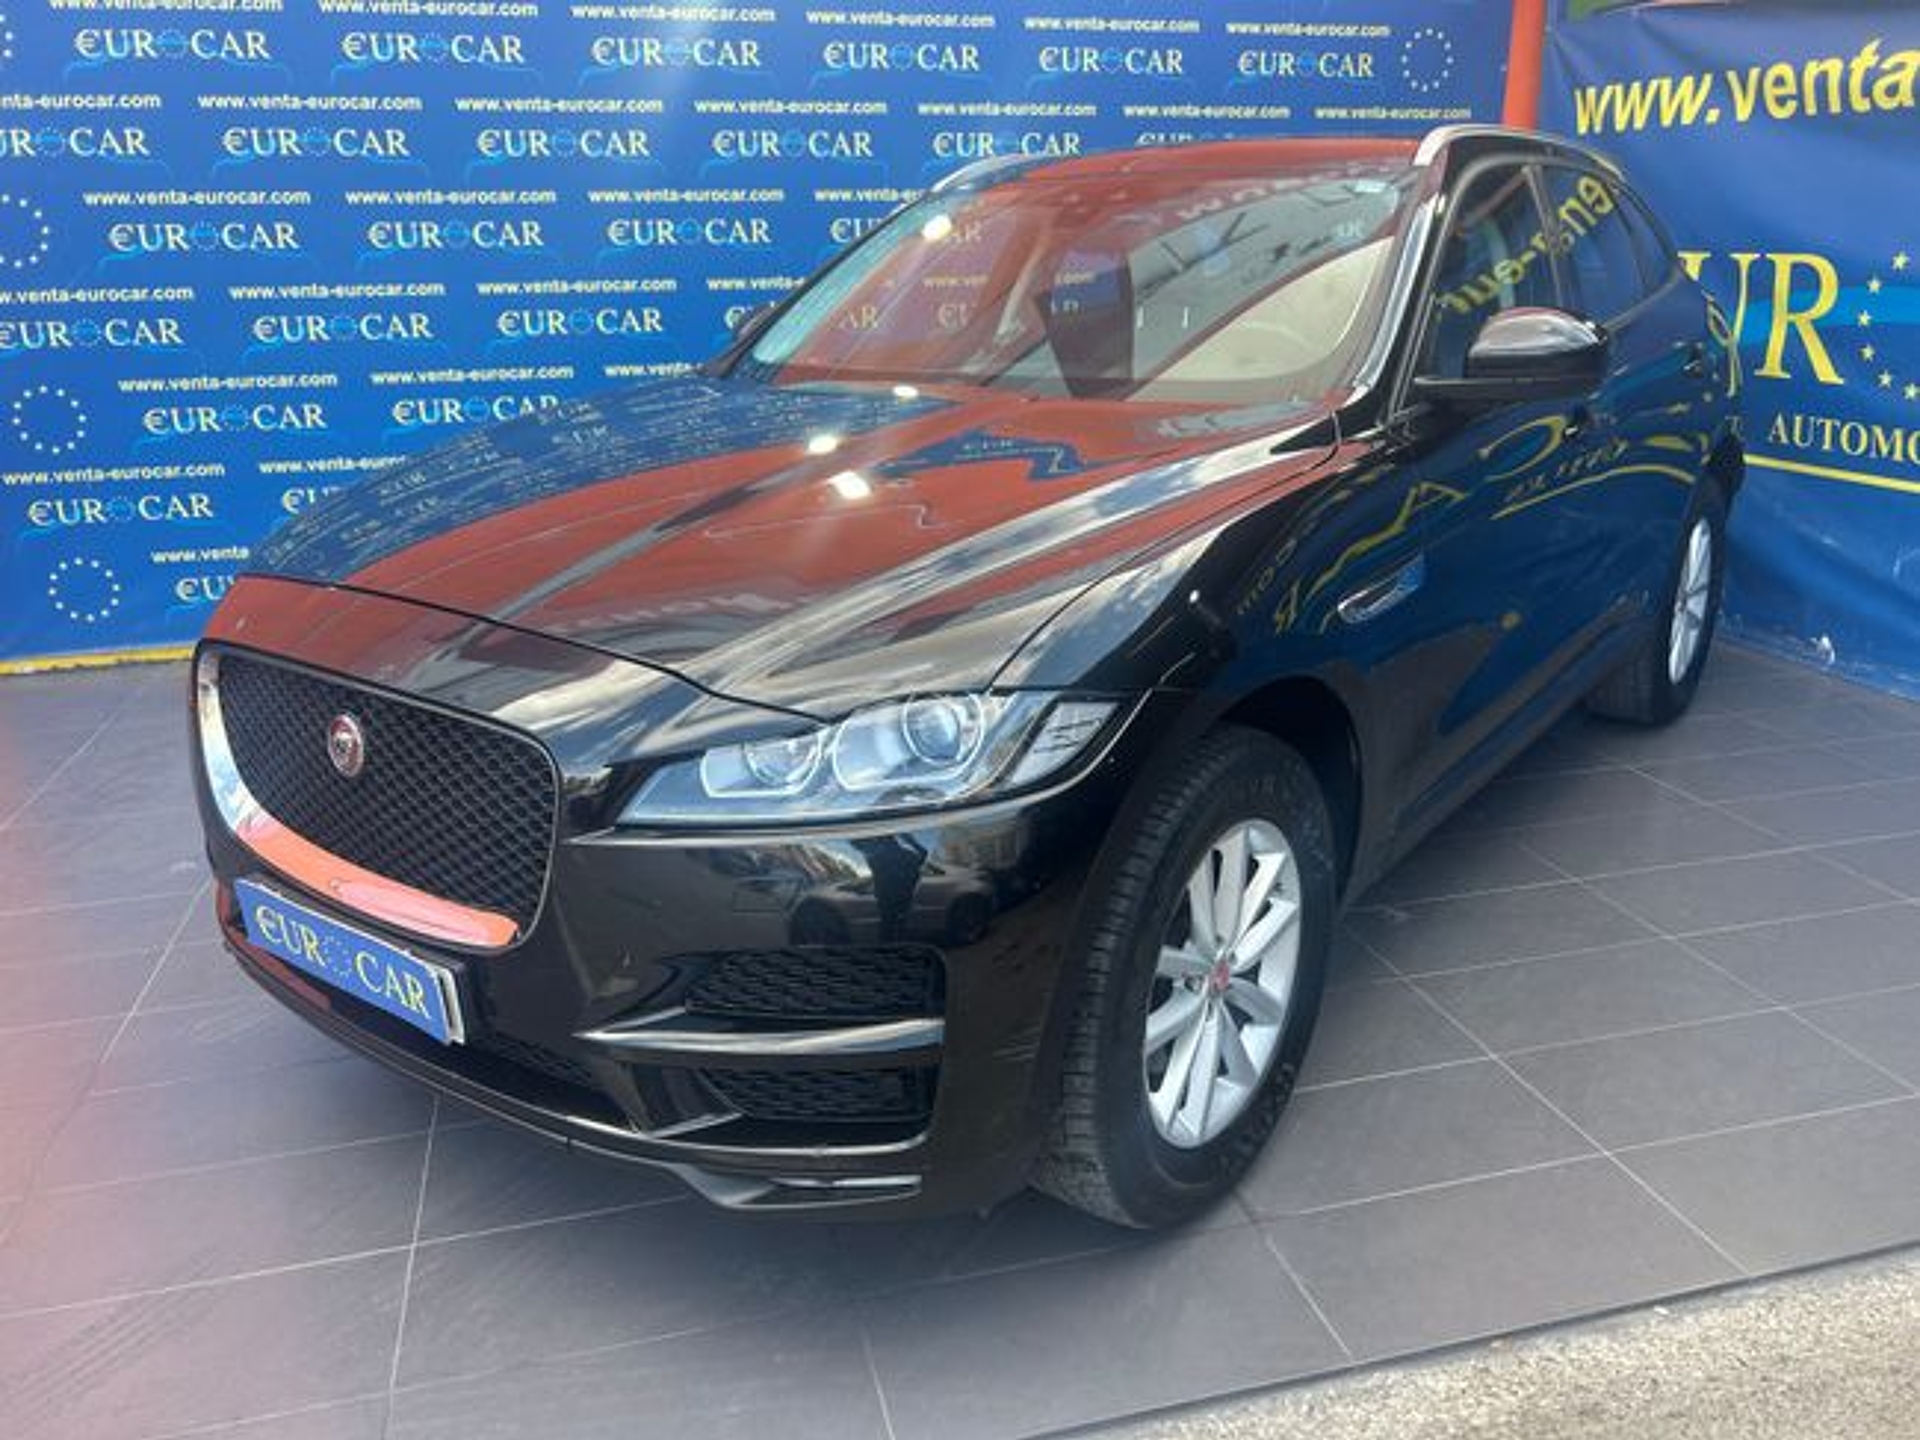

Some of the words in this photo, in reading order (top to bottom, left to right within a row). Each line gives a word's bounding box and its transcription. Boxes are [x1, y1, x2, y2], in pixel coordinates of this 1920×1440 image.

[319, 0, 538, 17] www.venta-eurocar.com
[573, 1, 775, 24] www.venta-eurocar.com
[805, 10, 996, 28] www.venta-eurocar.com
[1024, 17, 1200, 33] www.venta-eurocar.com
[1225, 22, 1391, 38] www.venta-eurocar.com
[198, 94, 423, 111] www.venta-eurocar.com
[455, 97, 664, 114] www.venta-eurocar.com
[694, 99, 888, 115] www.venta-eurocar.com
[917, 101, 1097, 117] www.venta-eurocar.com
[1123, 104, 1291, 119] www.venta-eurocar.com
[83, 189, 311, 206] www.venta-eurocar.com
[345, 189, 557, 205] www.venta-eurocar.com
[588, 188, 784, 203] www.venta-eurocar.com
[229, 282, 445, 300] www.venta-eurocar.com
[476, 279, 677, 296] www.venta-eurocar.com
[117, 372, 338, 392] www.venta-eurocar.com
[370, 366, 574, 385] www.venta-eurocar.com
[2, 463, 226, 486] www.venta-eurocar.com
